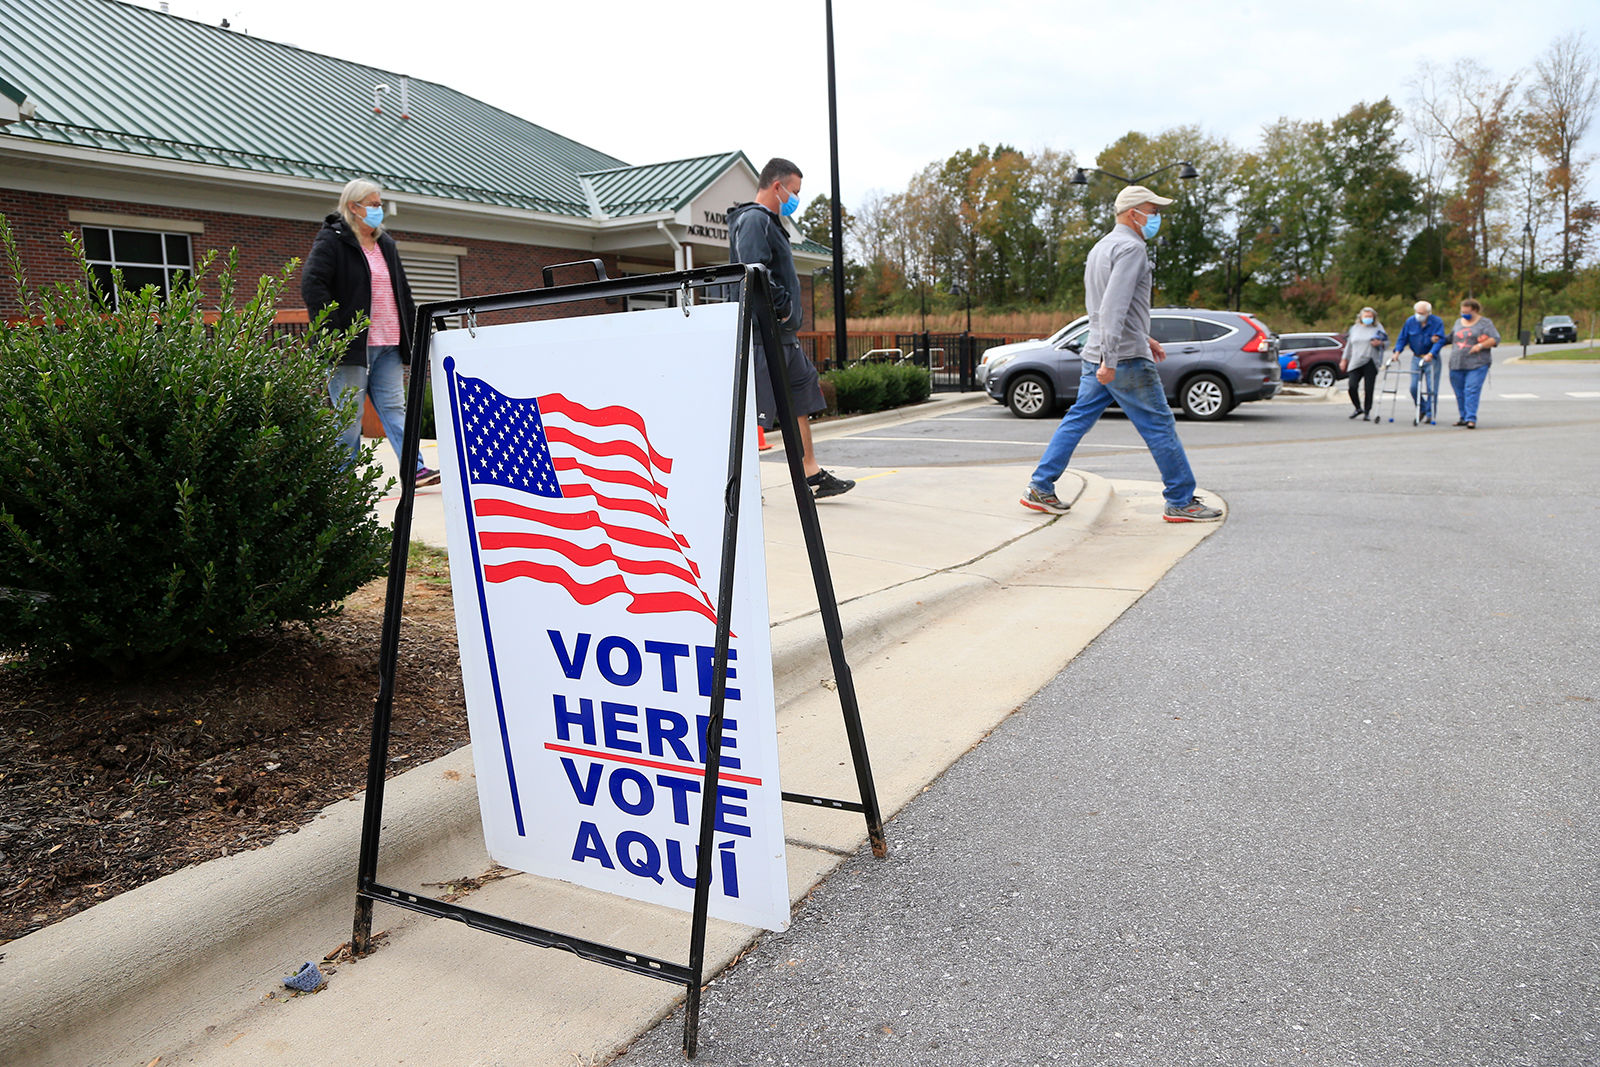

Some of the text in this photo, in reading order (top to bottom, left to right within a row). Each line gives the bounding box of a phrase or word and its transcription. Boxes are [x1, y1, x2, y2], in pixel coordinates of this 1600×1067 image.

[547, 629, 742, 701] VOTE
[552, 694, 742, 770] HERE
[560, 757, 752, 838] VOTE
[571, 821, 739, 899] AQUÍ
